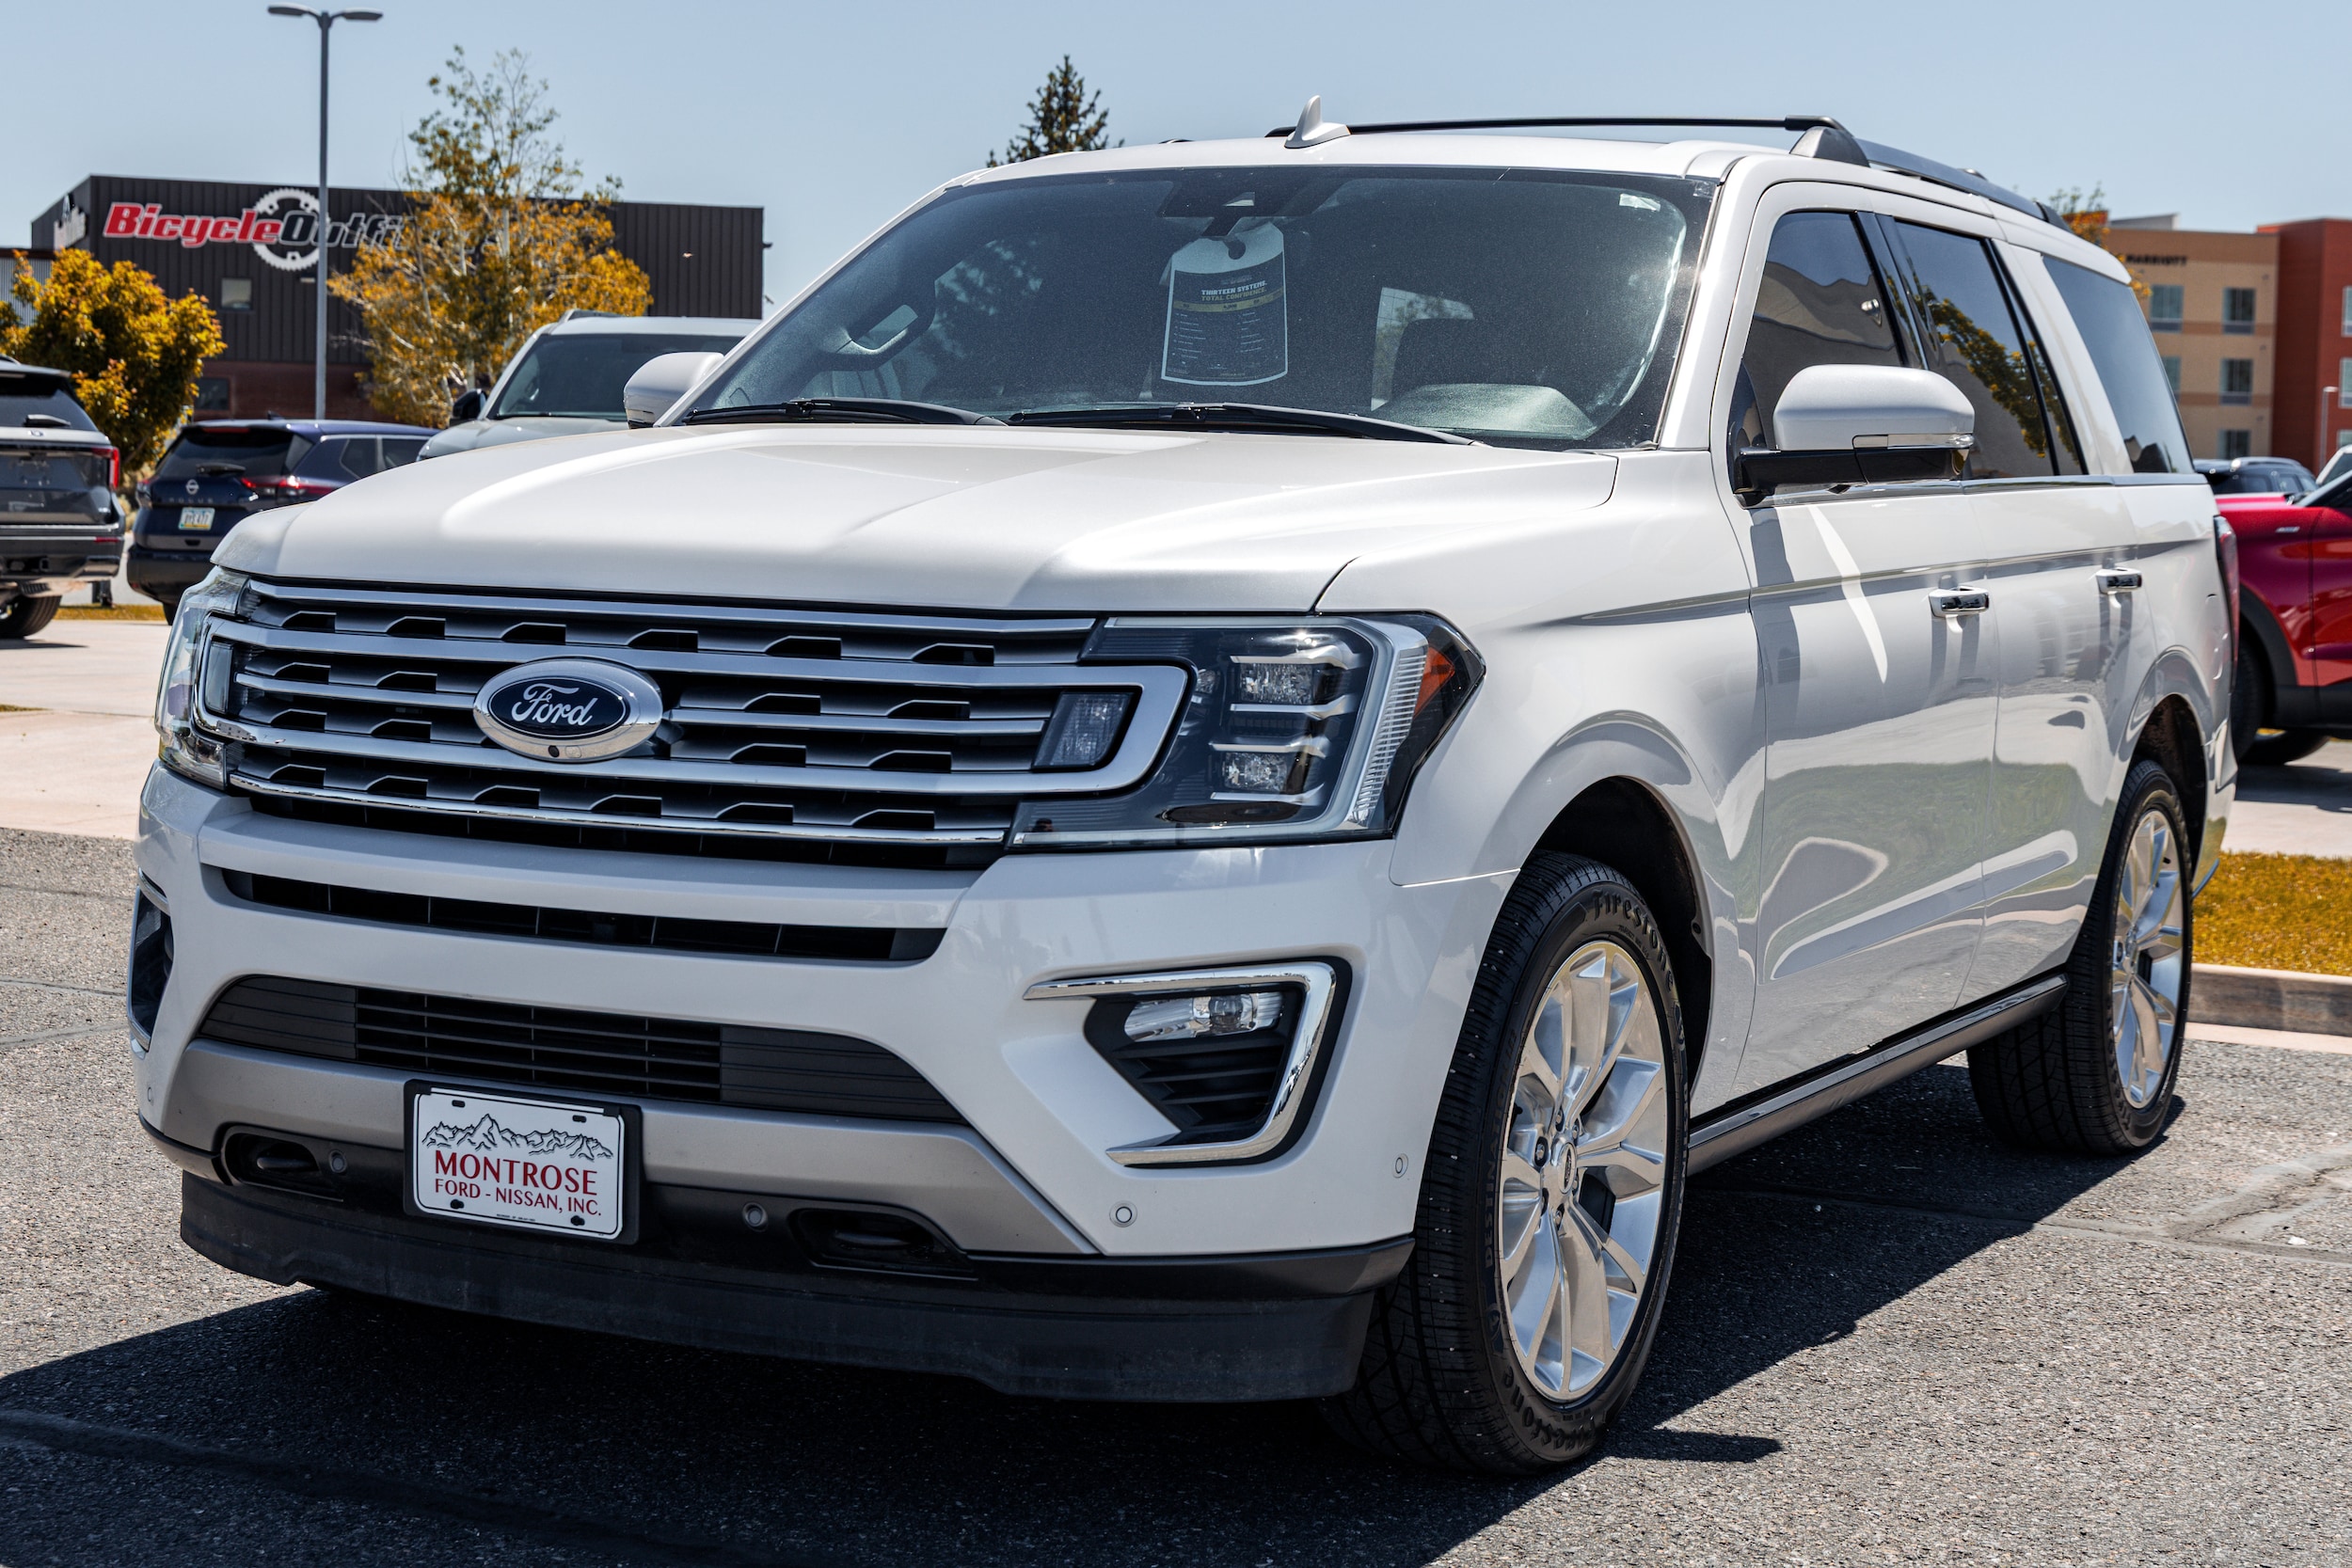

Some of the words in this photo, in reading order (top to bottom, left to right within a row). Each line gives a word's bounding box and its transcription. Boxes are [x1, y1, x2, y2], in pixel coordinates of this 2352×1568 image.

[1200, 287, 1236, 296] THIRTEEN
[1236, 279, 1268, 293] SYSTEMS.
[512, 683, 598, 726] Ford
[1593, 890, 1675, 992] Firestone
[435, 1149, 598, 1196] MONTROSE
[434, 1178, 481, 1199] FORD
[495, 1187, 564, 1213] NISSAN,
[567, 1196, 602, 1216] INC.
